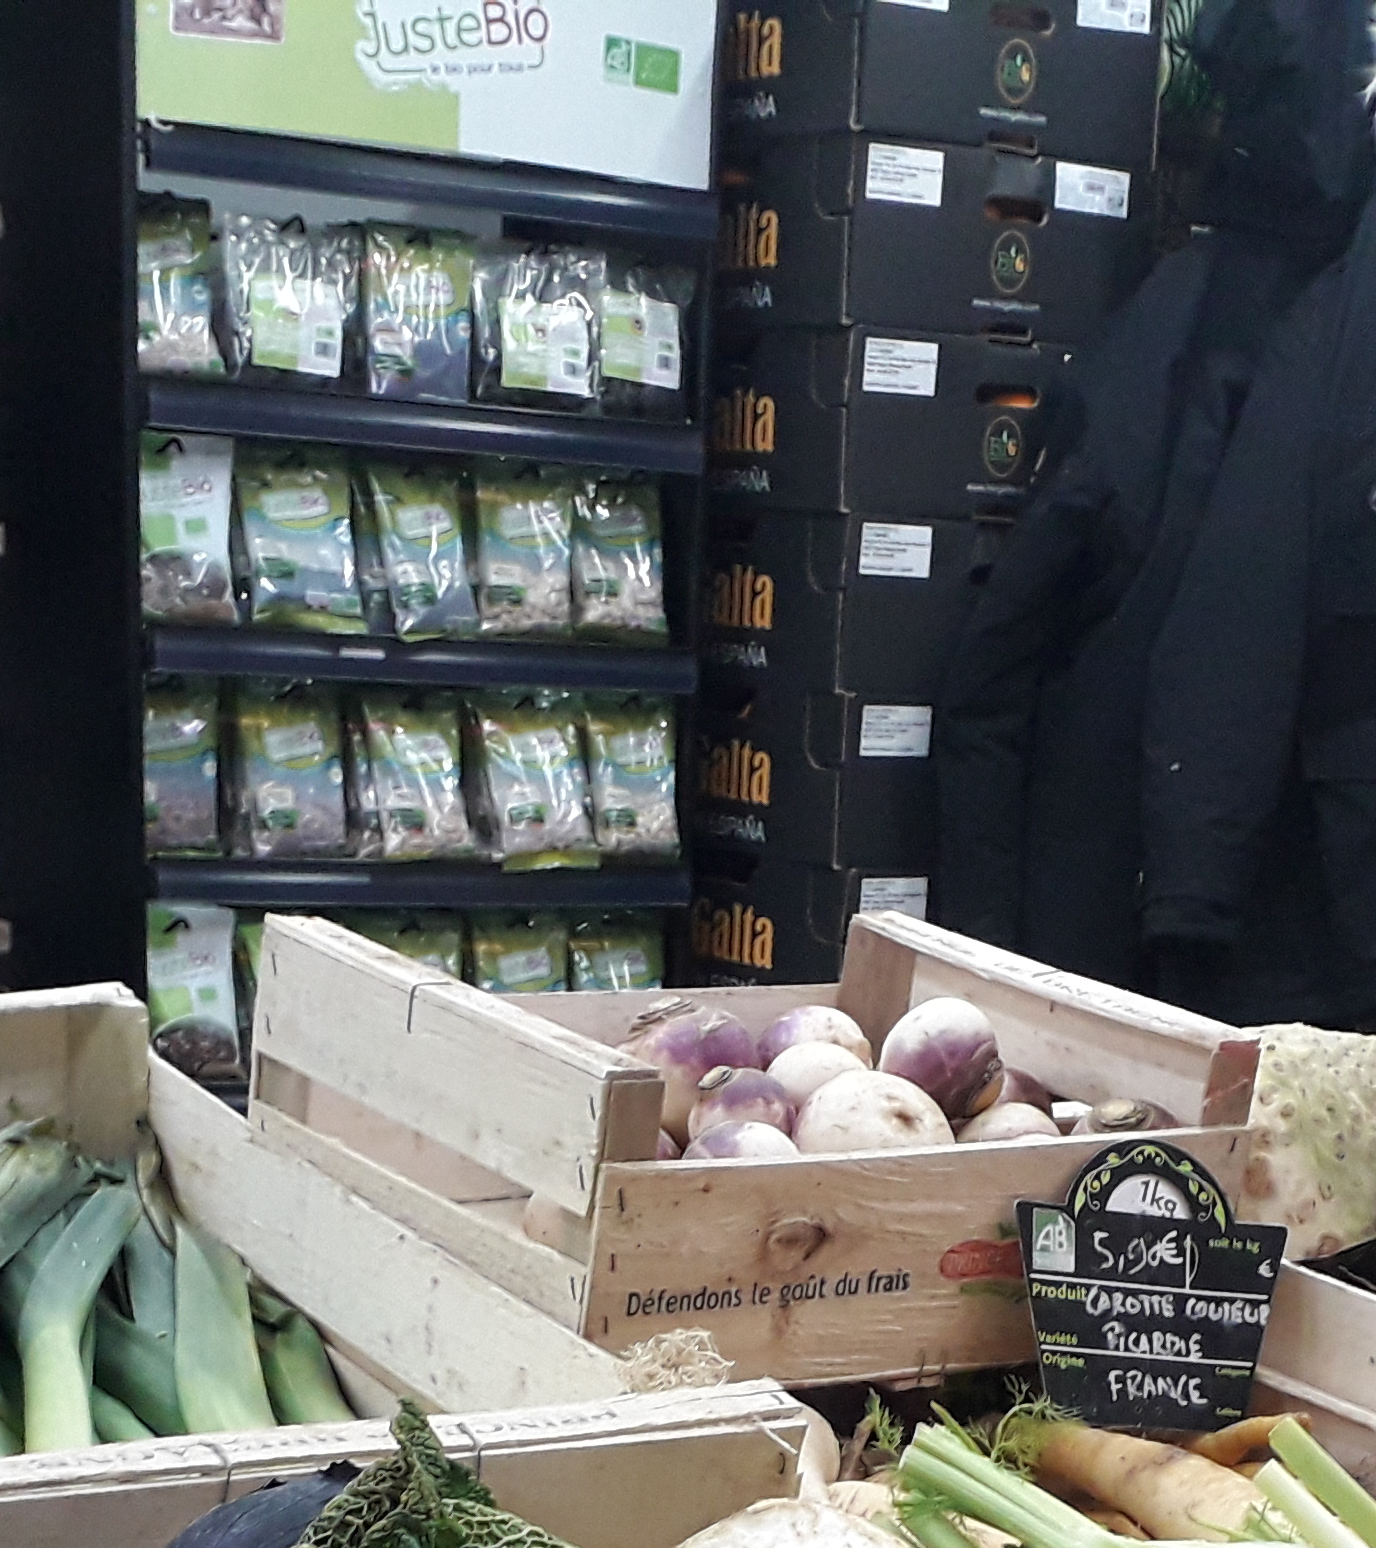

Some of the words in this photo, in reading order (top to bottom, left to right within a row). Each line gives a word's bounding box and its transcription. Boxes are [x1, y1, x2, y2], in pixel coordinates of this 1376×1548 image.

[360, 0, 549, 58] JusteBio
[1139, 1179, 1178, 1218] 1kg
[625, 1287, 742, 1317] Défendons
[751, 1281, 771, 1305] le
[780, 1274, 827, 1309] goût
[834, 1271, 860, 1297] du
[867, 1267, 911, 1294] frais
[1031, 1282, 1087, 1301] Produit
[1108, 1368, 1209, 1407] FRANCE
